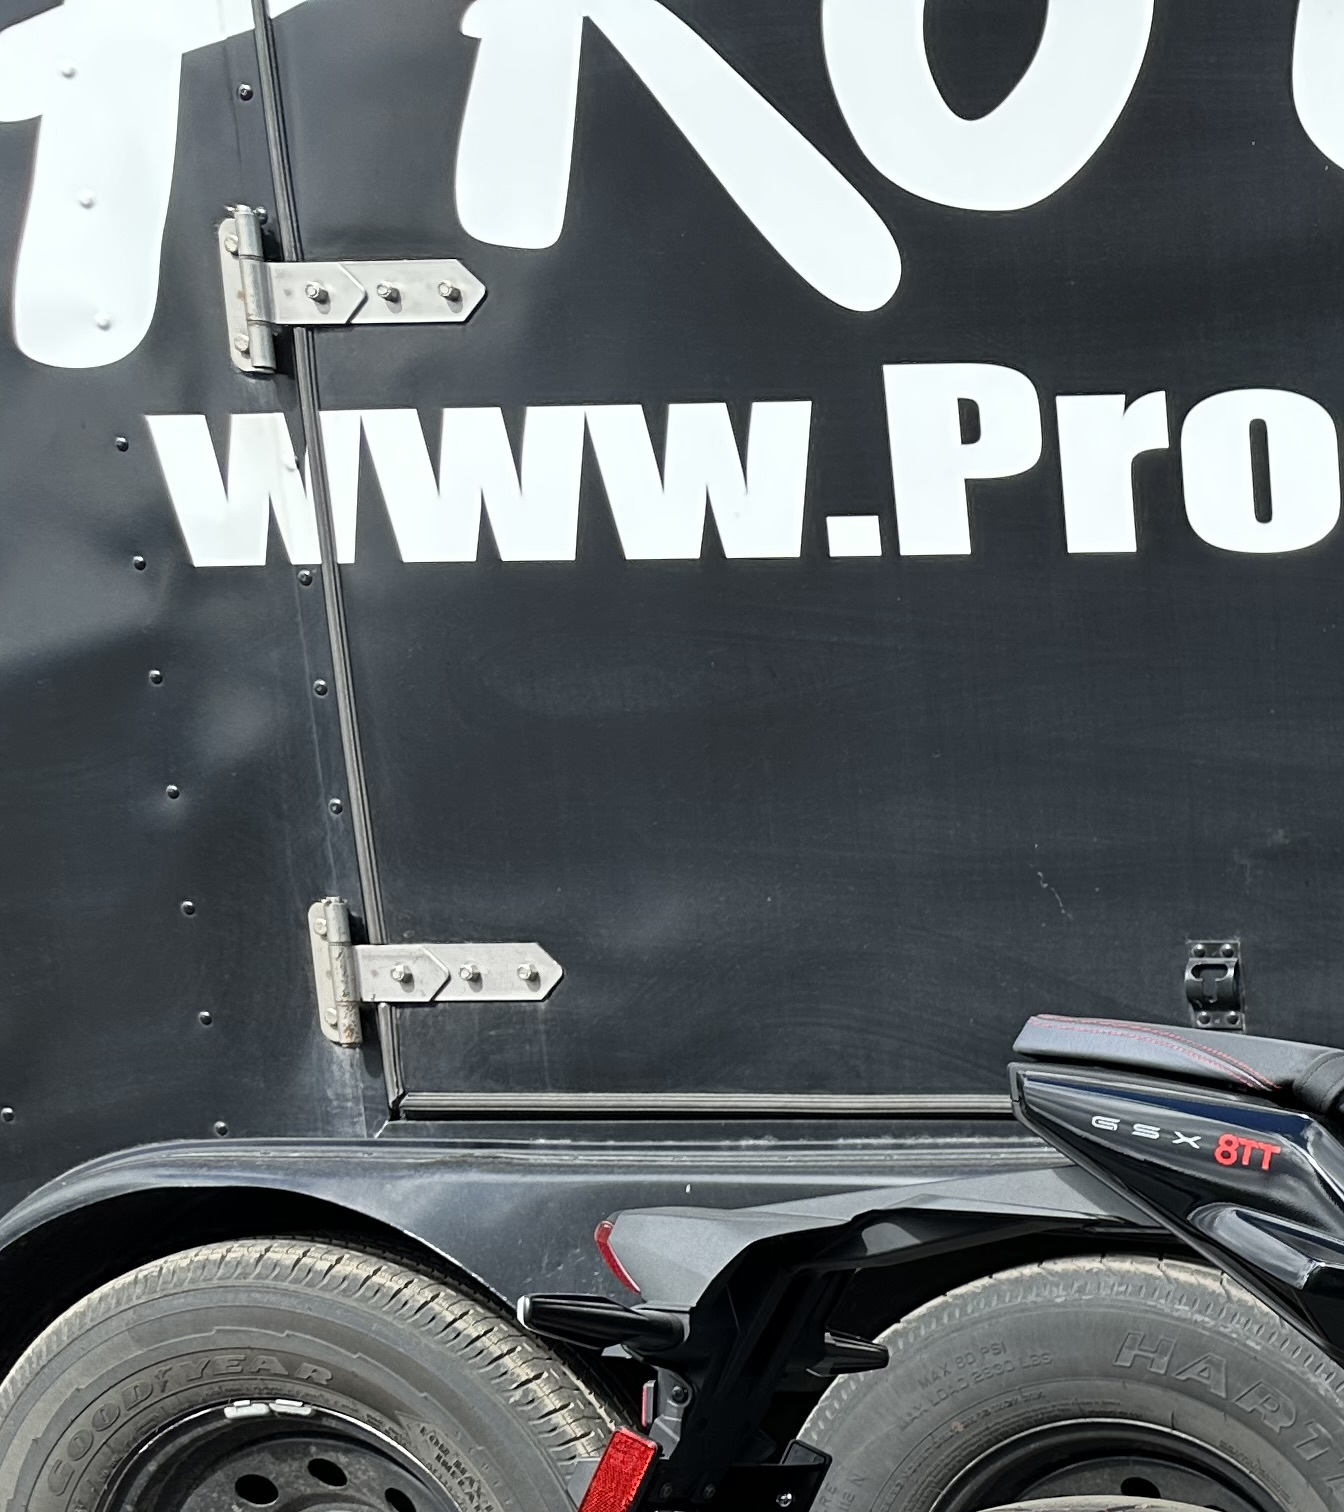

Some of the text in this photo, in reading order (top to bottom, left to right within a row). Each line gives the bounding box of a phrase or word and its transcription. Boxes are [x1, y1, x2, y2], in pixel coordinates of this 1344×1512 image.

[1091, 1115, 1282, 1171] GSX 8TT
[918, 1364, 951, 1391] MAX
[980, 1341, 1008, 1362] PSI
[47, 1354, 334, 1497] GOODYEAR
[419, 1425, 451, 1458] FOR
[453, 1458, 485, 1500] MAX
